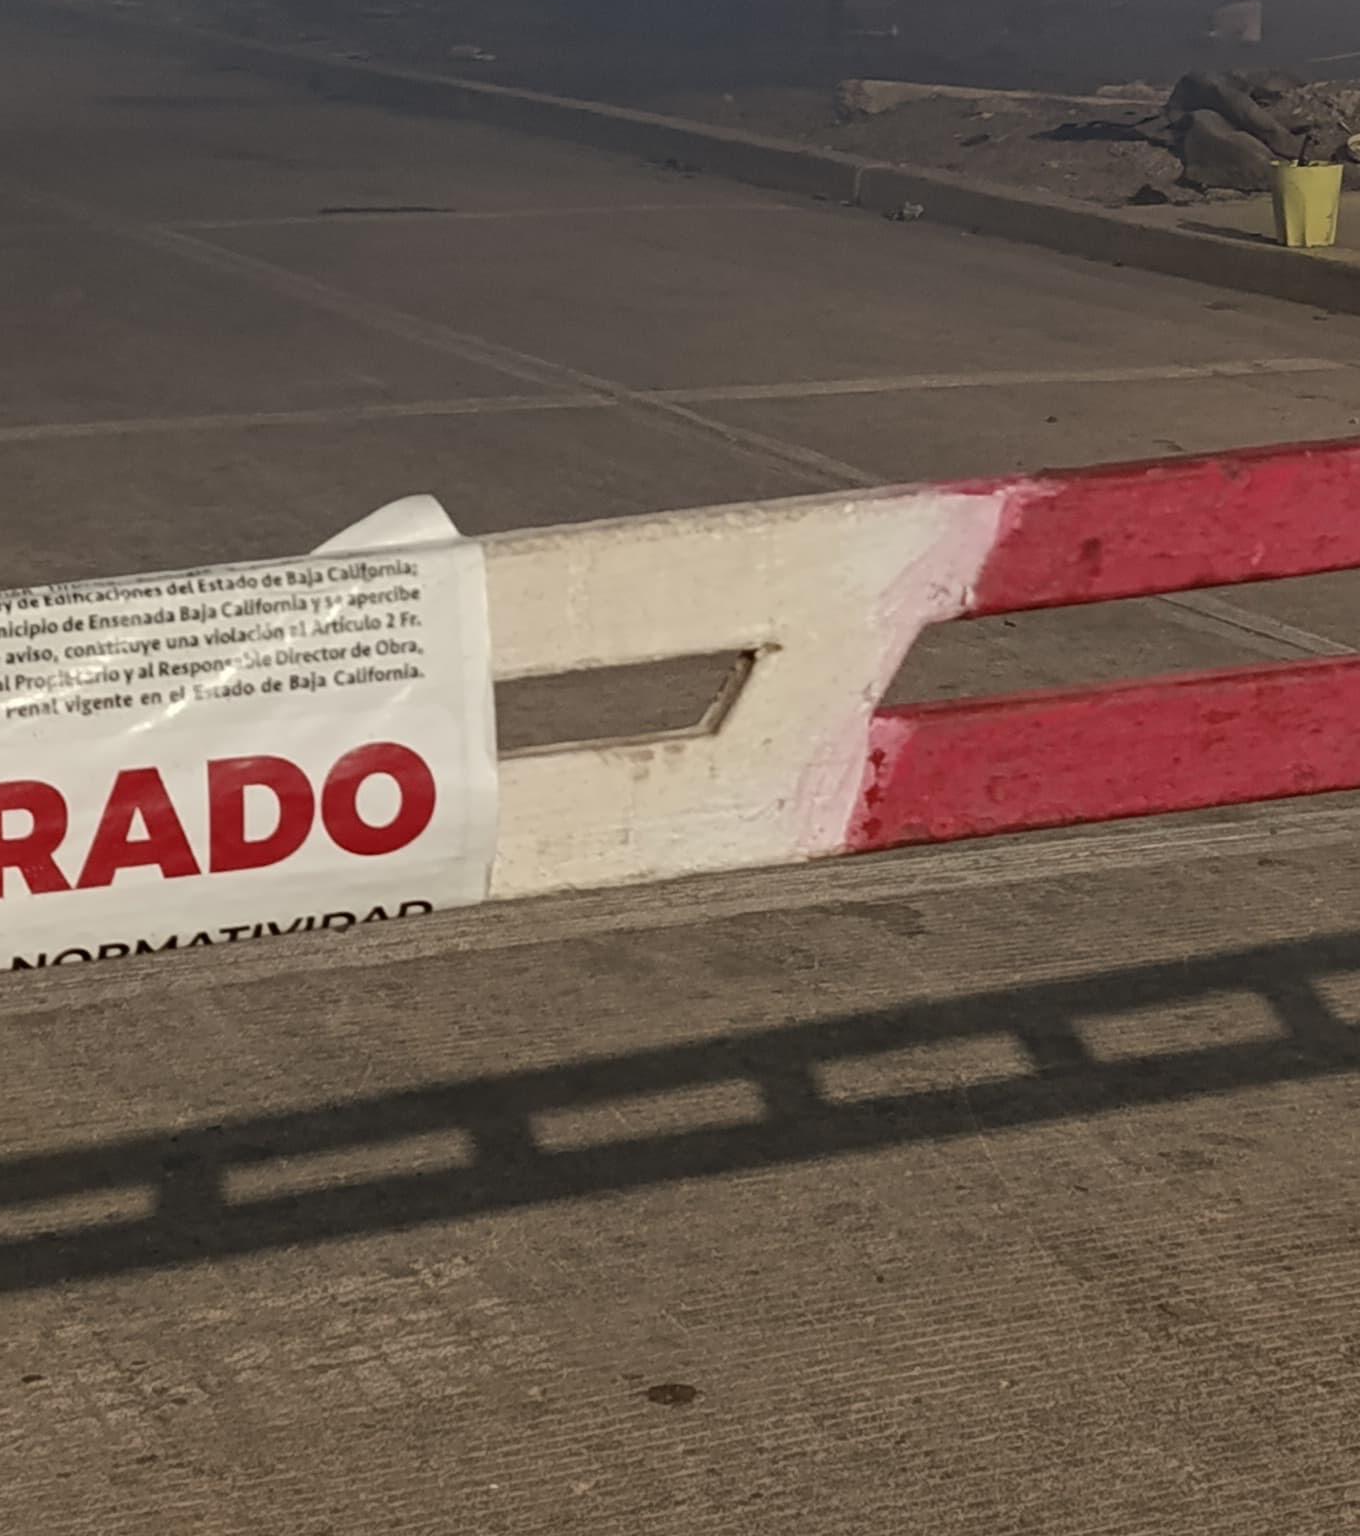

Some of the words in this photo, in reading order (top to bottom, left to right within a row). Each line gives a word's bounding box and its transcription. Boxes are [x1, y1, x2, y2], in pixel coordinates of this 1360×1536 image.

[17, 597, 40, 611] de
[43, 585, 163, 608] Edificaciones
[166, 579, 195, 597] del
[197, 574, 259, 594] Estado
[261, 572, 283, 589] de
[285, 567, 324, 589] Baja
[326, 559, 419, 584] California;
[62, 615, 85, 634] de
[89, 607, 176, 631] Ensenada
[179, 603, 218, 625] Baja
[221, 592, 307, 619] California
[346, 585, 420, 611] apercibe
[5, 645, 59, 666] aviso,
[166, 634, 200, 651] una
[203, 623, 284, 647] violación
[385, 611, 396, 630] 2
[399, 610, 422, 629] Fr.
[123, 668, 134, 686] y
[137, 661, 155, 680] al
[275, 646, 347, 667] Director
[350, 641, 372, 659] de
[375, 637, 422, 657] Obra,
[64, 692, 134, 717] vigente
[139, 691, 163, 707] en
[169, 684, 186, 704] el
[260, 676, 284, 695] de
[288, 671, 327, 693] Baja
[333, 662, 425, 687] California.
